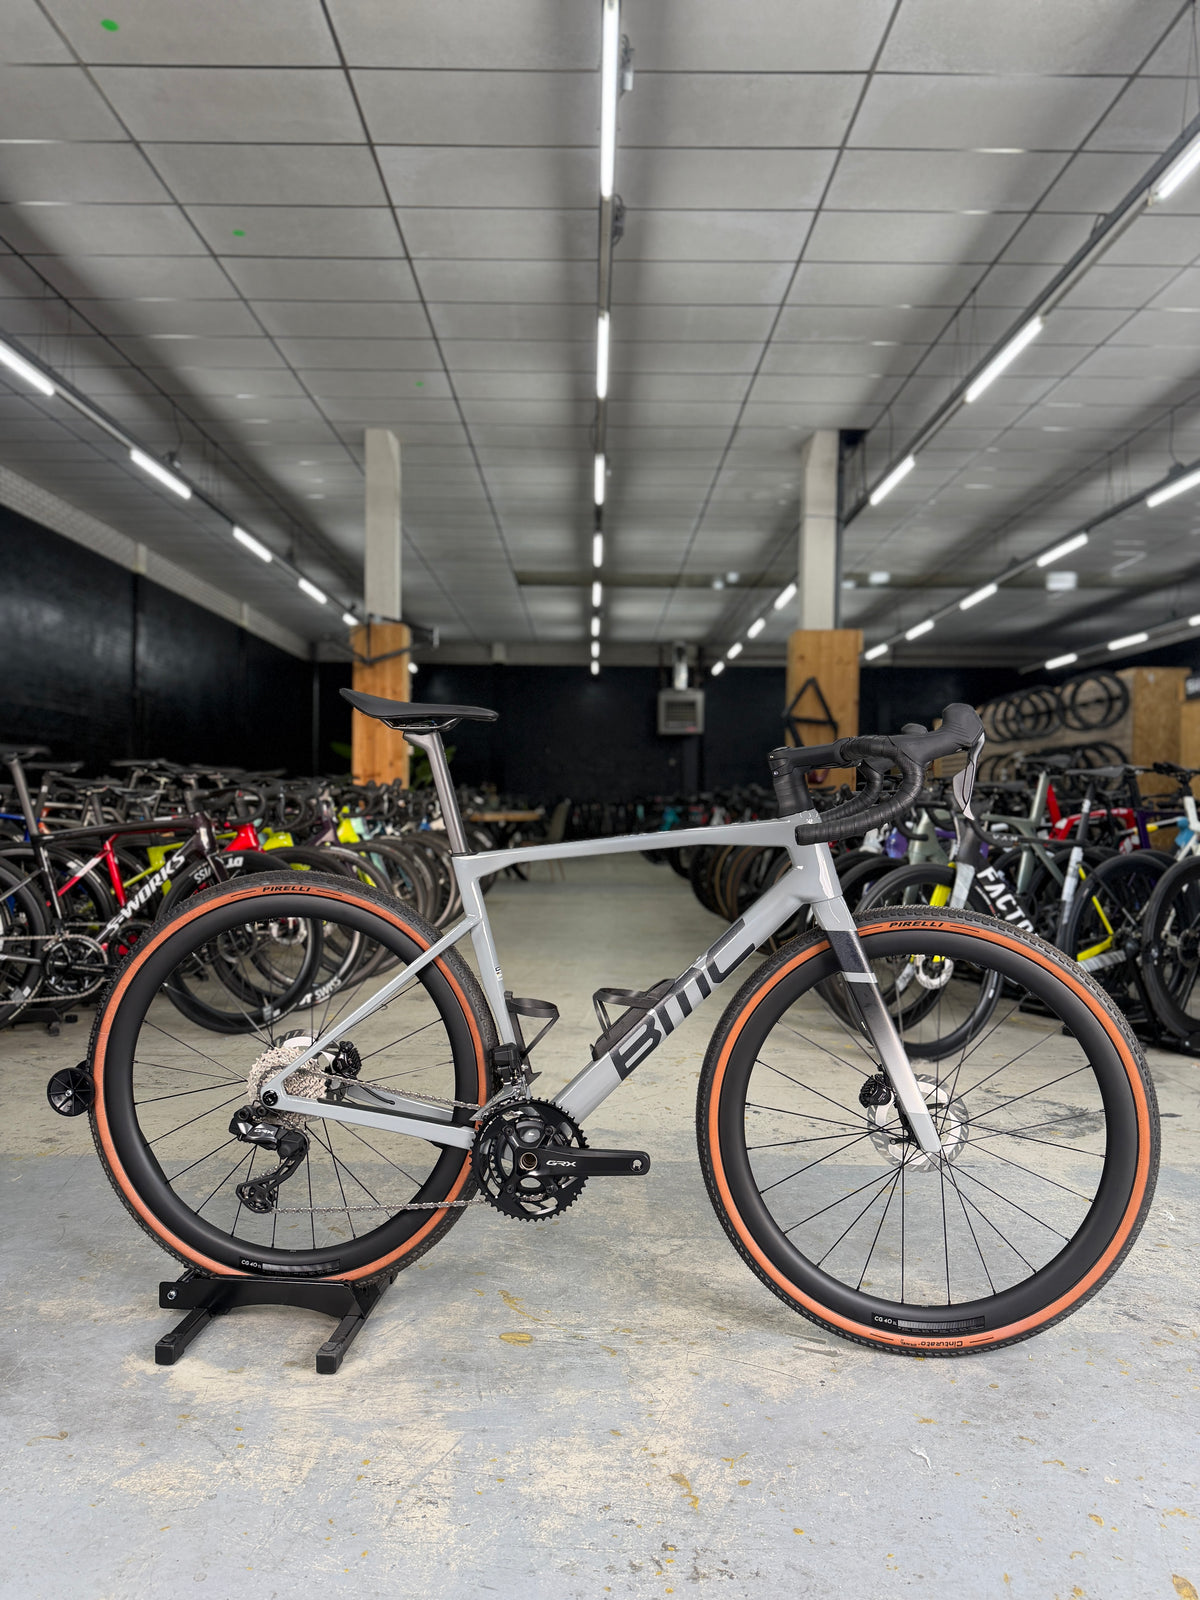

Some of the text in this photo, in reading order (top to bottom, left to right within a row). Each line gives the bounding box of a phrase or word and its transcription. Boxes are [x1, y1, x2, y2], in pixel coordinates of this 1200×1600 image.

[105, 854, 186, 937] S-WORKS
[225, 856, 244, 869] DT
[976, 866, 1039, 936] FACTO
[609, 918, 755, 1081] BMC
